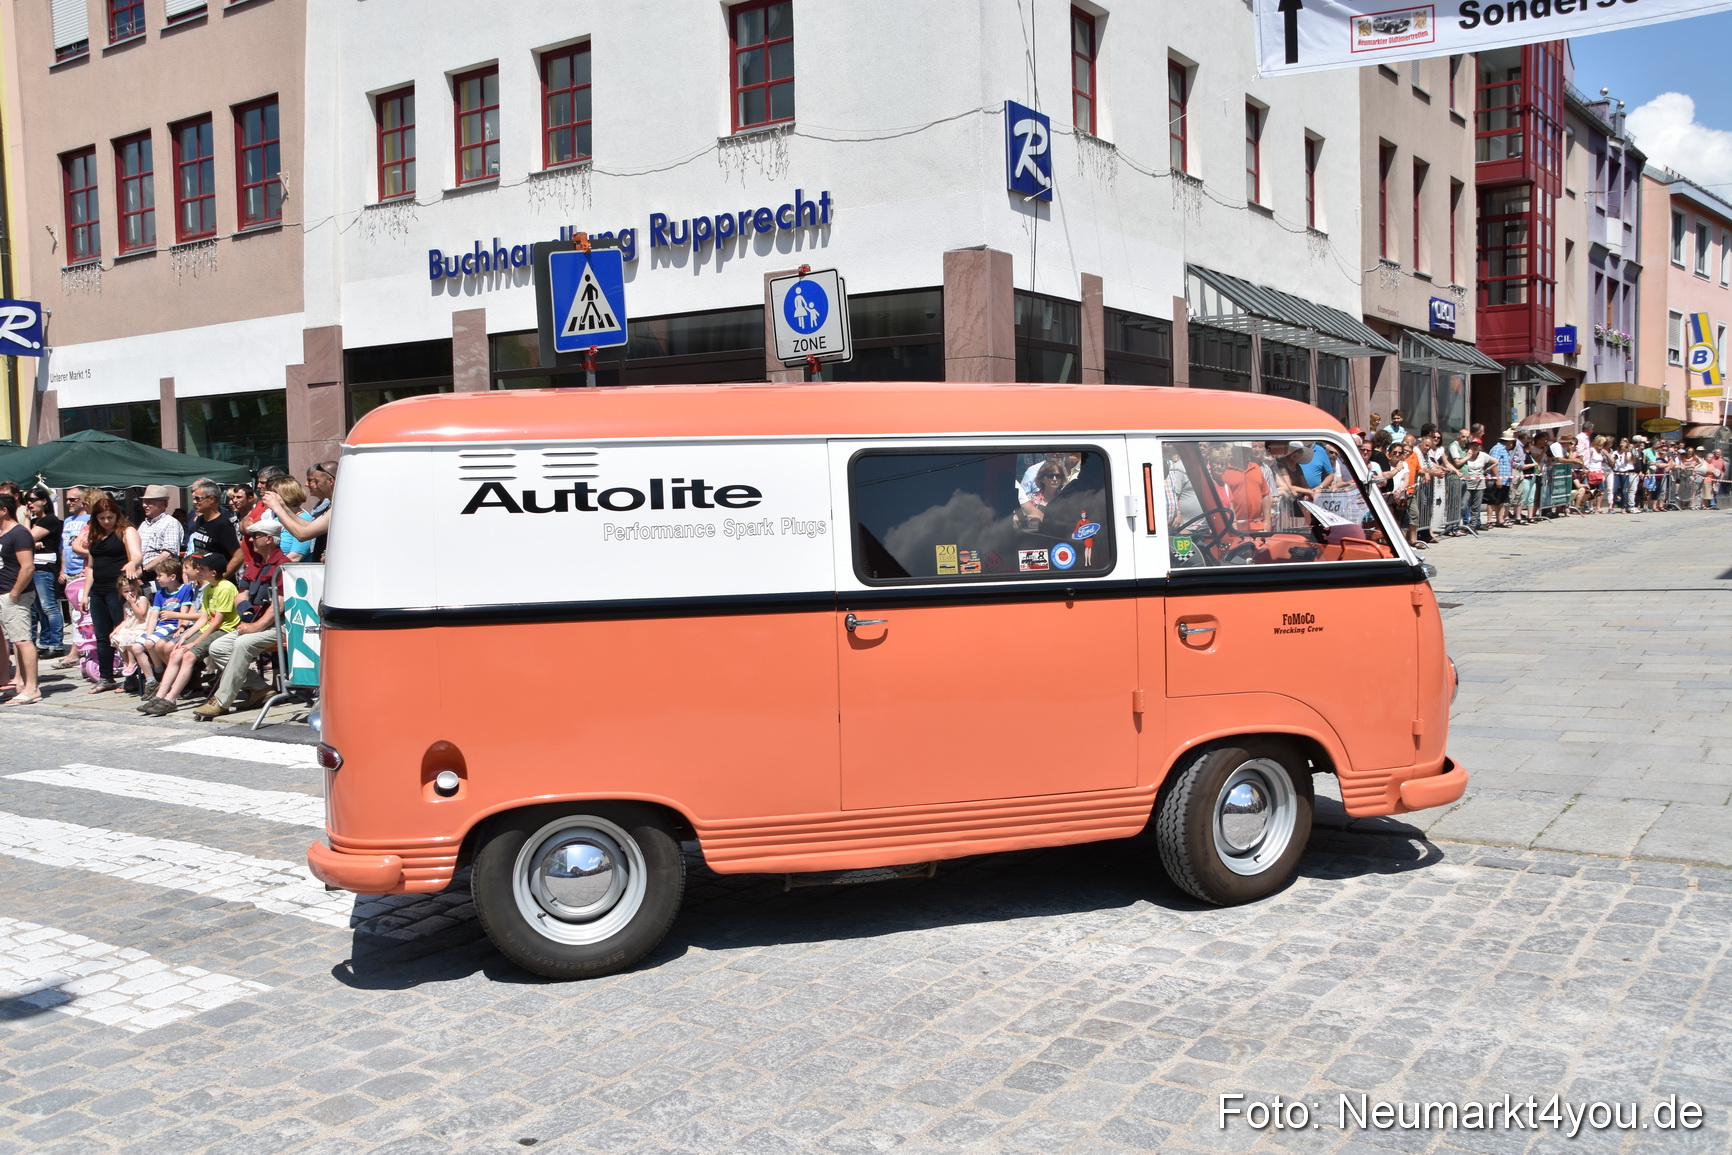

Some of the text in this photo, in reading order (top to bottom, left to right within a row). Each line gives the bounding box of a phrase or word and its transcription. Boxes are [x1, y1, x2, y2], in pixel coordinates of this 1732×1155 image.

[1459, 0, 1639, 30] Sonde
[1357, 30, 1429, 46] Neumarkter Oldtimertreffen
[428, 188, 832, 281] Buchhag Rupprecht
[793, 335, 827, 353] ZONE
[1692, 350, 1708, 365] B
[50, 368, 92, 383] Unterer Markt 15
[460, 477, 763, 515] Autolite
[603, 516, 828, 542] Performance Spark Plugs
[1077, 524, 1096, 538] Ford
[938, 545, 956, 556] 20
[1176, 539, 1191, 551] BP
[1282, 612, 1315, 626] FoMoCo
[1273, 625, 1325, 635] Wrecking Crew
